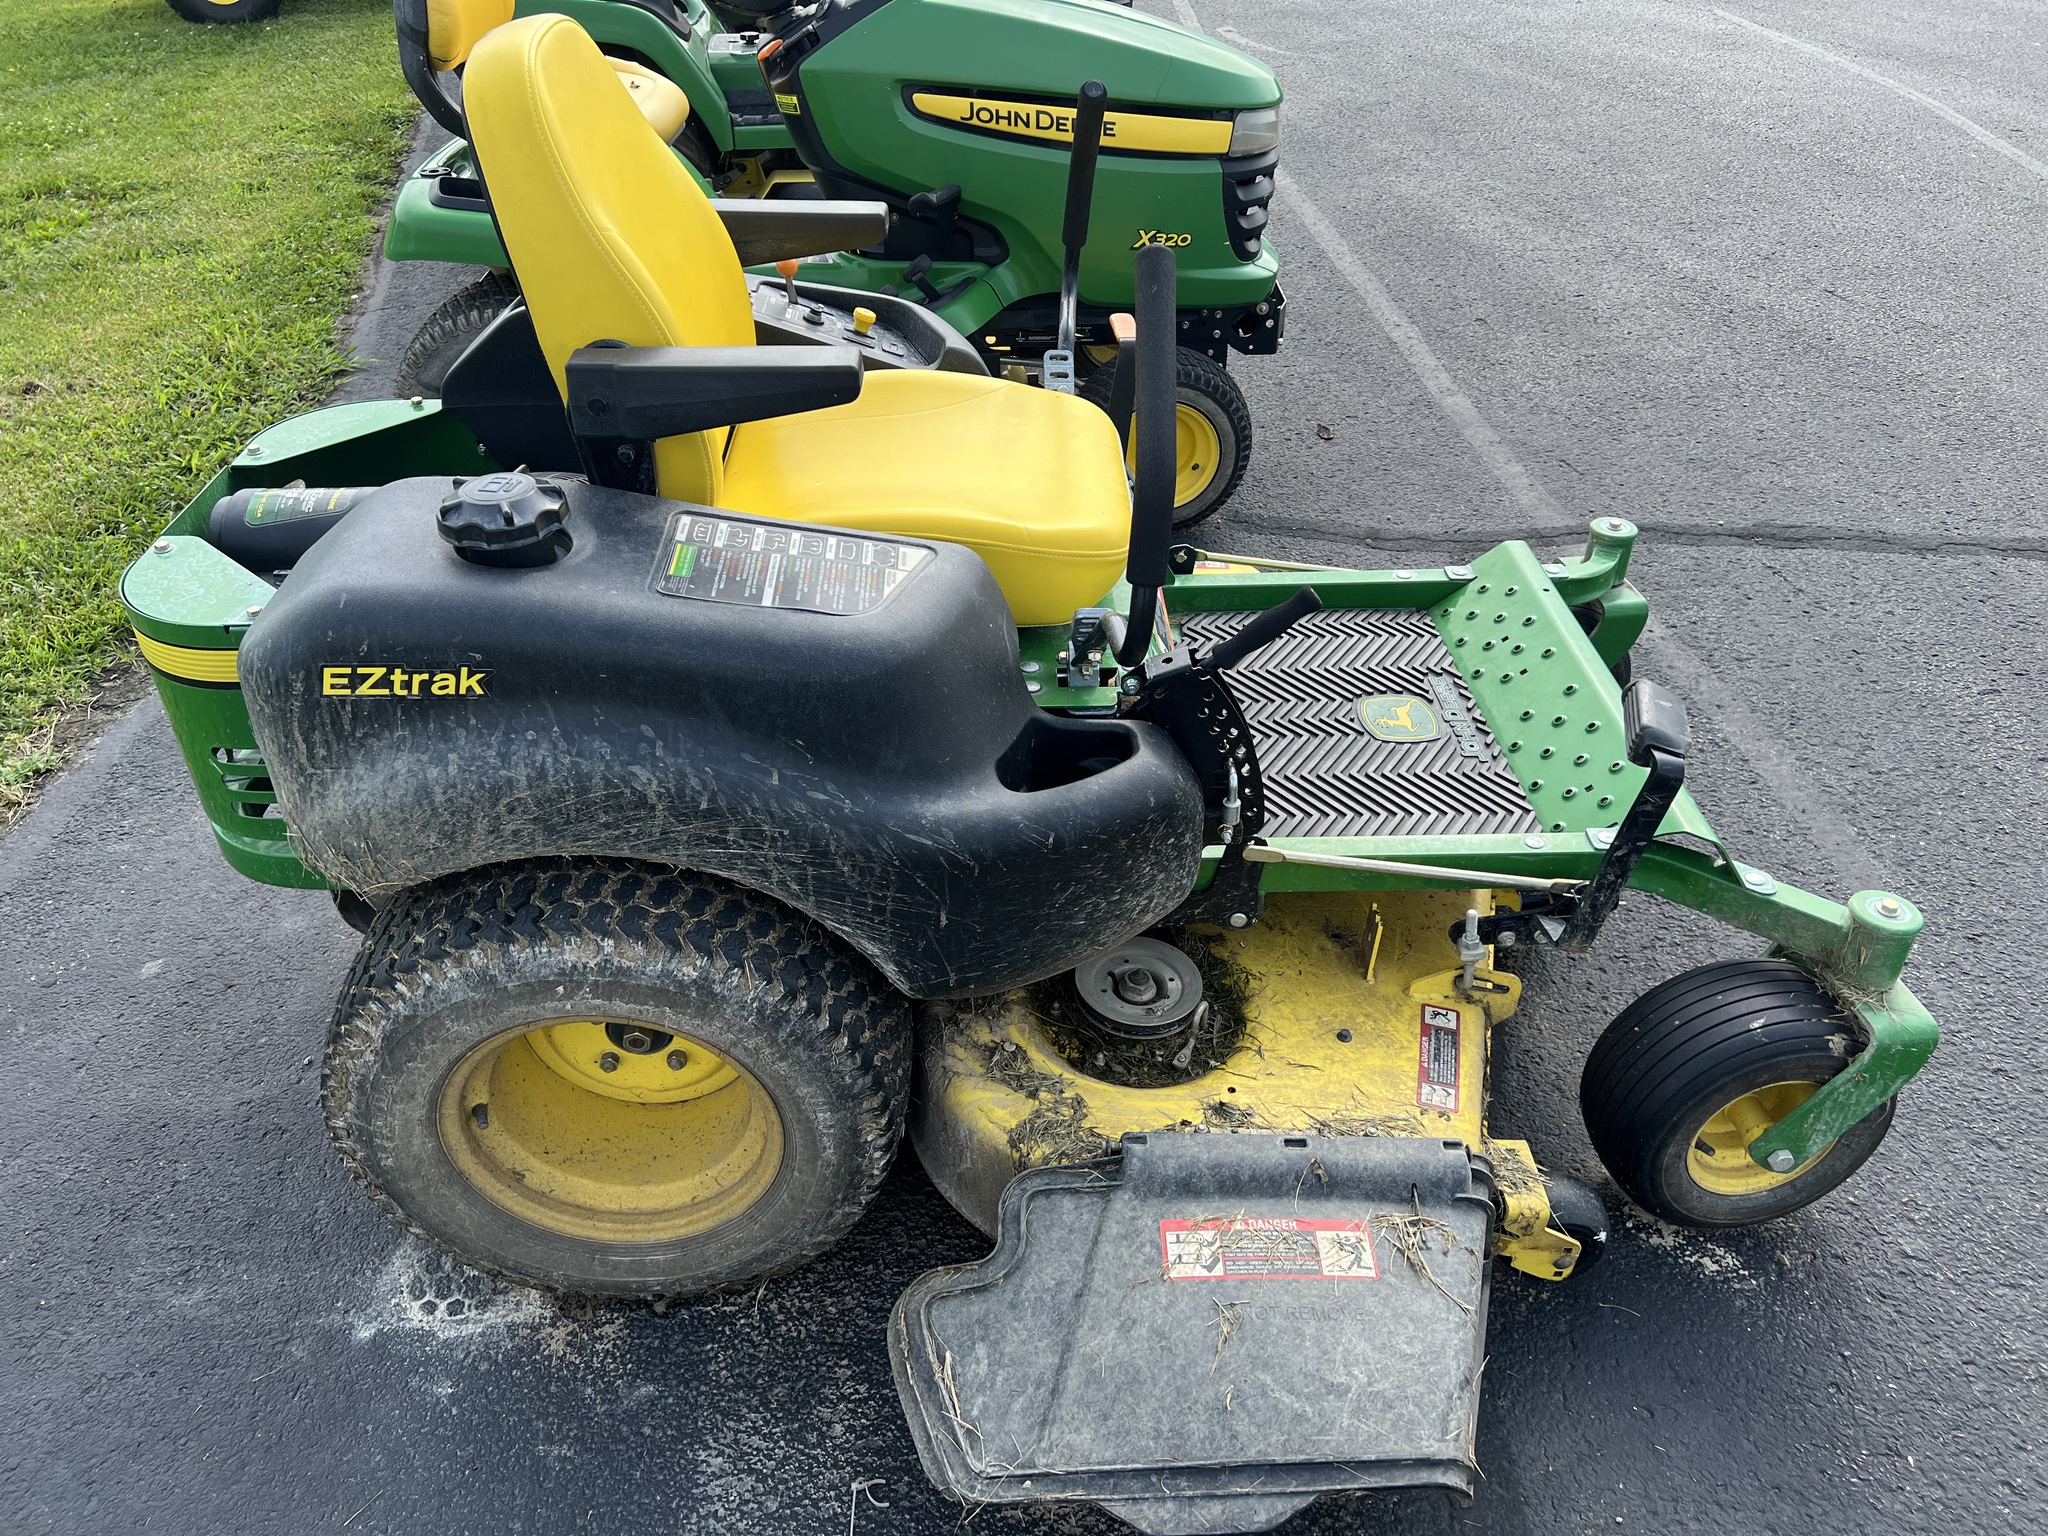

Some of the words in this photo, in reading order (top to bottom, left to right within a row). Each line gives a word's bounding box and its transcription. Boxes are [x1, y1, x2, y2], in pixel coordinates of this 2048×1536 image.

[960, 102, 1031, 129] JOHN
[1035, 109, 1117, 138] DEE
[1132, 229, 1192, 247] X320
[322, 666, 487, 696] EZtrak
[1432, 676, 1467, 720] DEERE
[1453, 721, 1487, 761] JOHN
[1421, 1036, 1429, 1062] DANGER
[1248, 1219, 1298, 1230] DANGER
